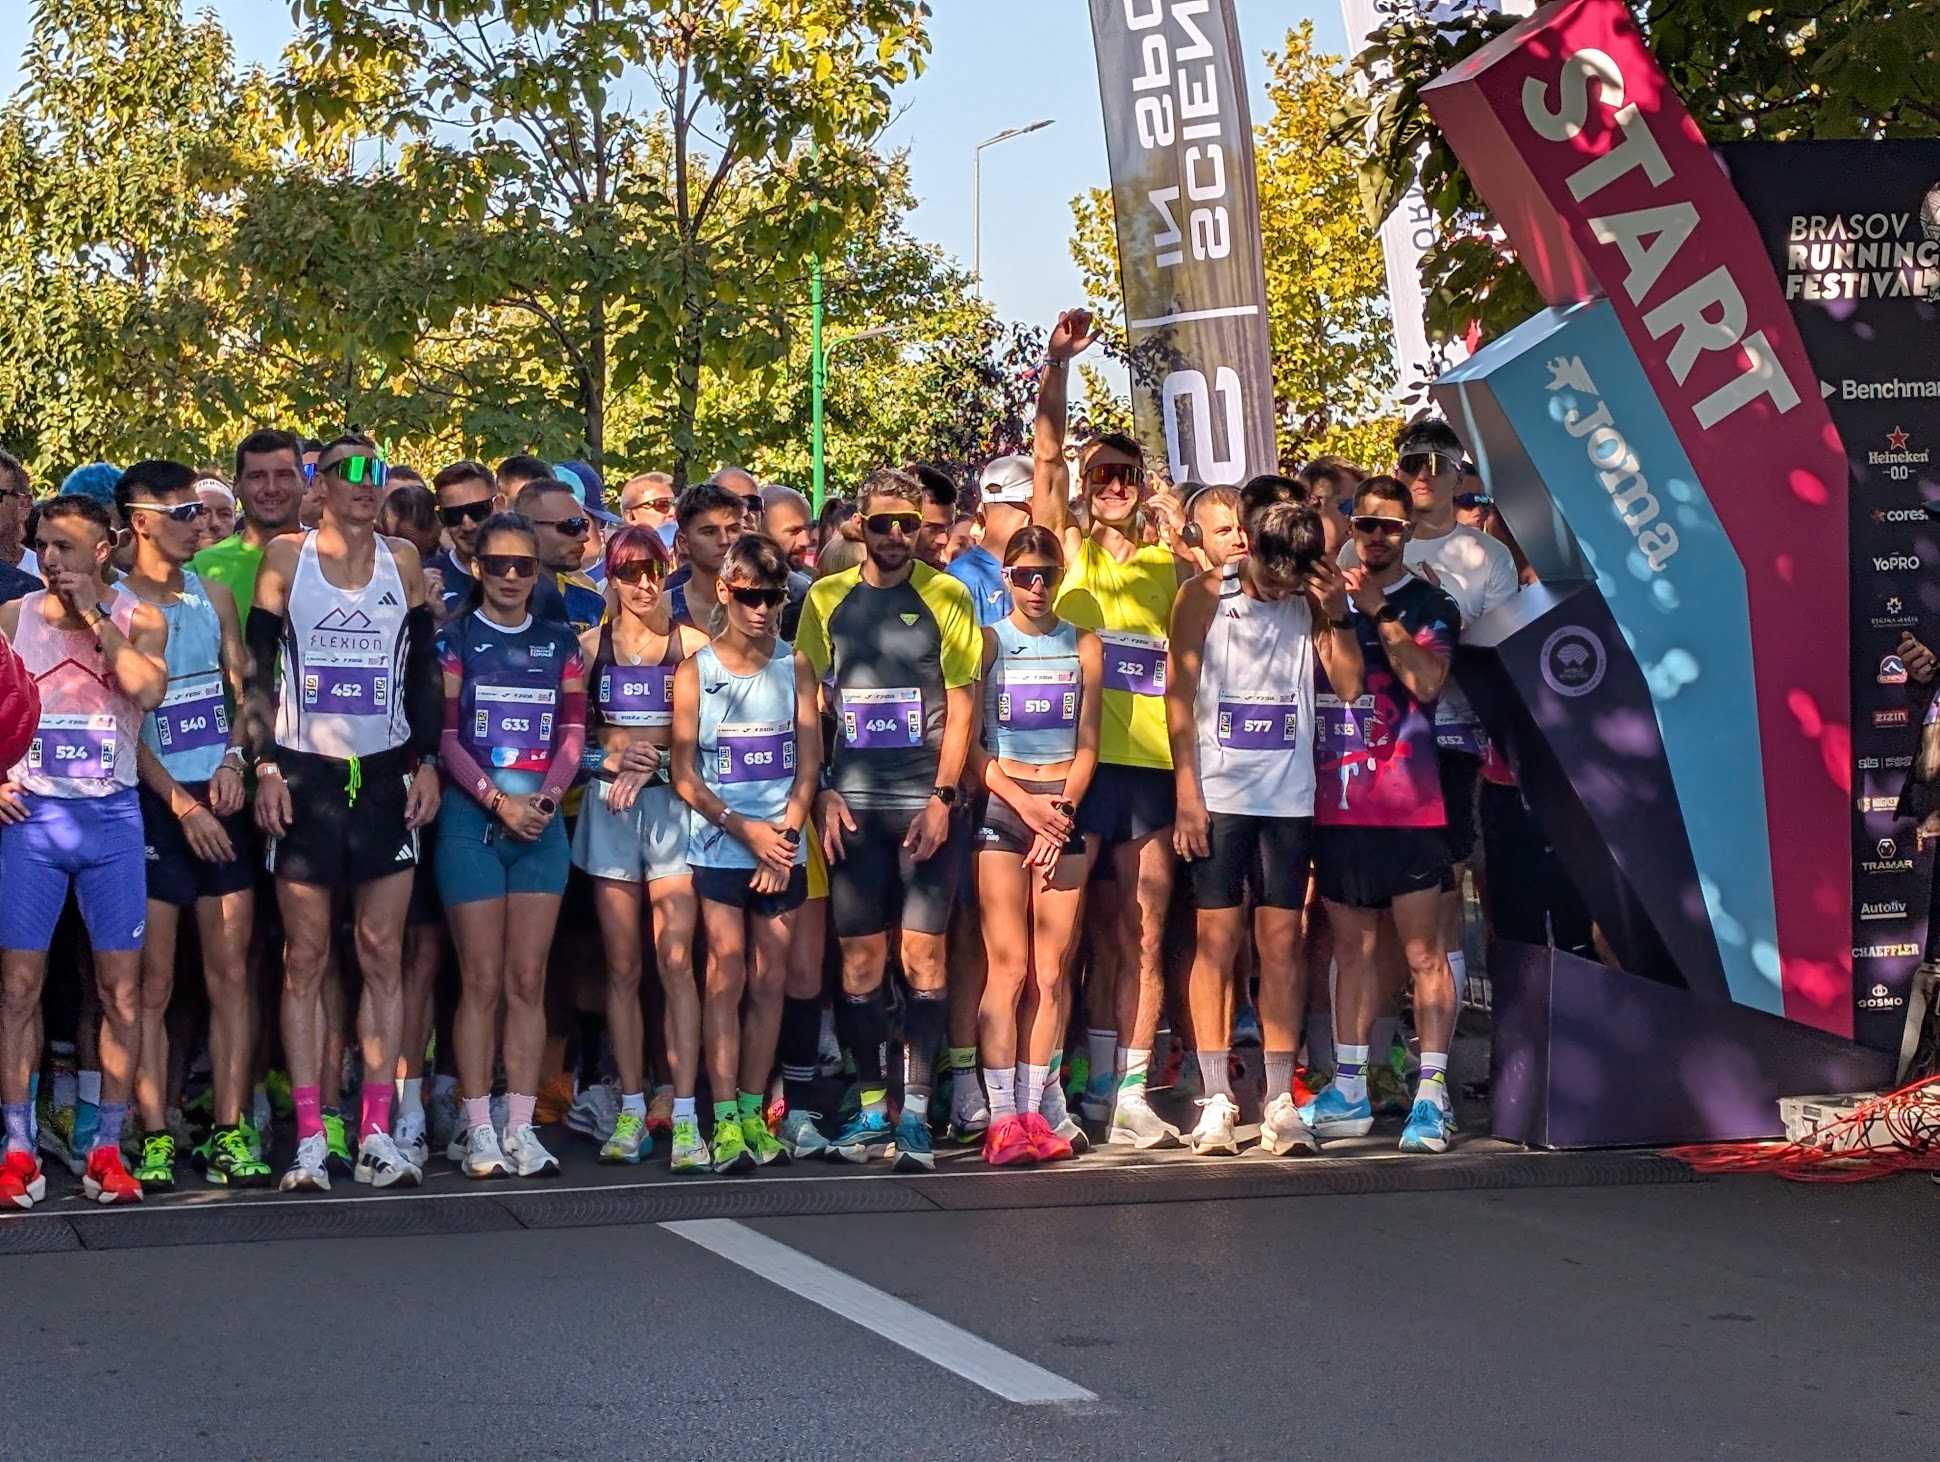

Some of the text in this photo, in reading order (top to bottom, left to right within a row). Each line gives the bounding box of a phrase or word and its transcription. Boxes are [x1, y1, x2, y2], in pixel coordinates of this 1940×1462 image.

[1790, 213, 1910, 241] BRASOV
[1522, 48, 1801, 430] START
[1788, 241, 1940, 270] RUNNING
[1786, 270, 1929, 300] FESTIVAL
[1869, 450, 1929, 464] Heineken
[1117, 661, 1144, 676] 252
[330, 683, 362, 697] 452
[1025, 699, 1051, 713] 519
[180, 715, 207, 733] 540
[501, 718, 530, 732] 633
[866, 719, 897, 732] 494
[1244, 719, 1273, 733] 577
[55, 745, 88, 760] 524
[743, 751, 773, 765] 683
[1861, 859, 1913, 871] TRAMAR
[1861, 900, 1907, 914] Autoliv
[1851, 943, 1920, 958] CHAEFFLER
